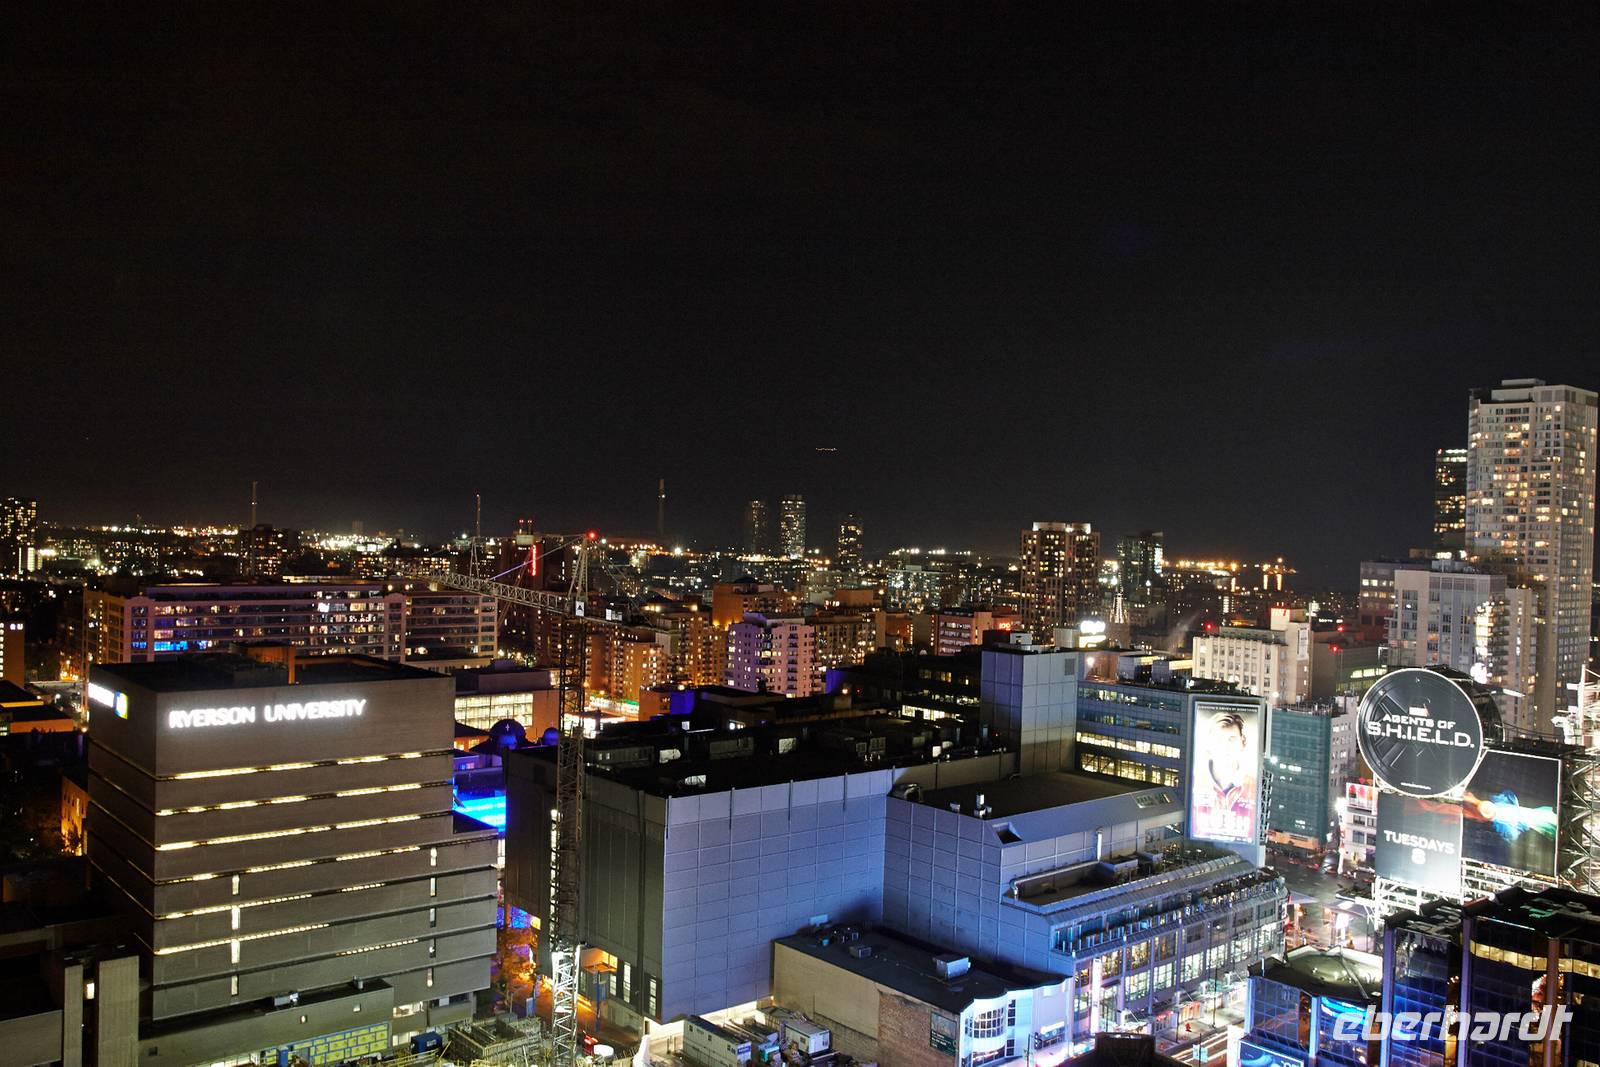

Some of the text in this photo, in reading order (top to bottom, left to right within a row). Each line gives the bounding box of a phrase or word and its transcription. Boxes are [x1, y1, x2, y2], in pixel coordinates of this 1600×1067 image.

[169, 698, 367, 729] RYERSON UNIVERSITY
[1382, 713, 1456, 730] AGENTS OF
[1367, 720, 1475, 749] S.H.I.E.L.D.
[1383, 829, 1456, 854] TUESDAYS
